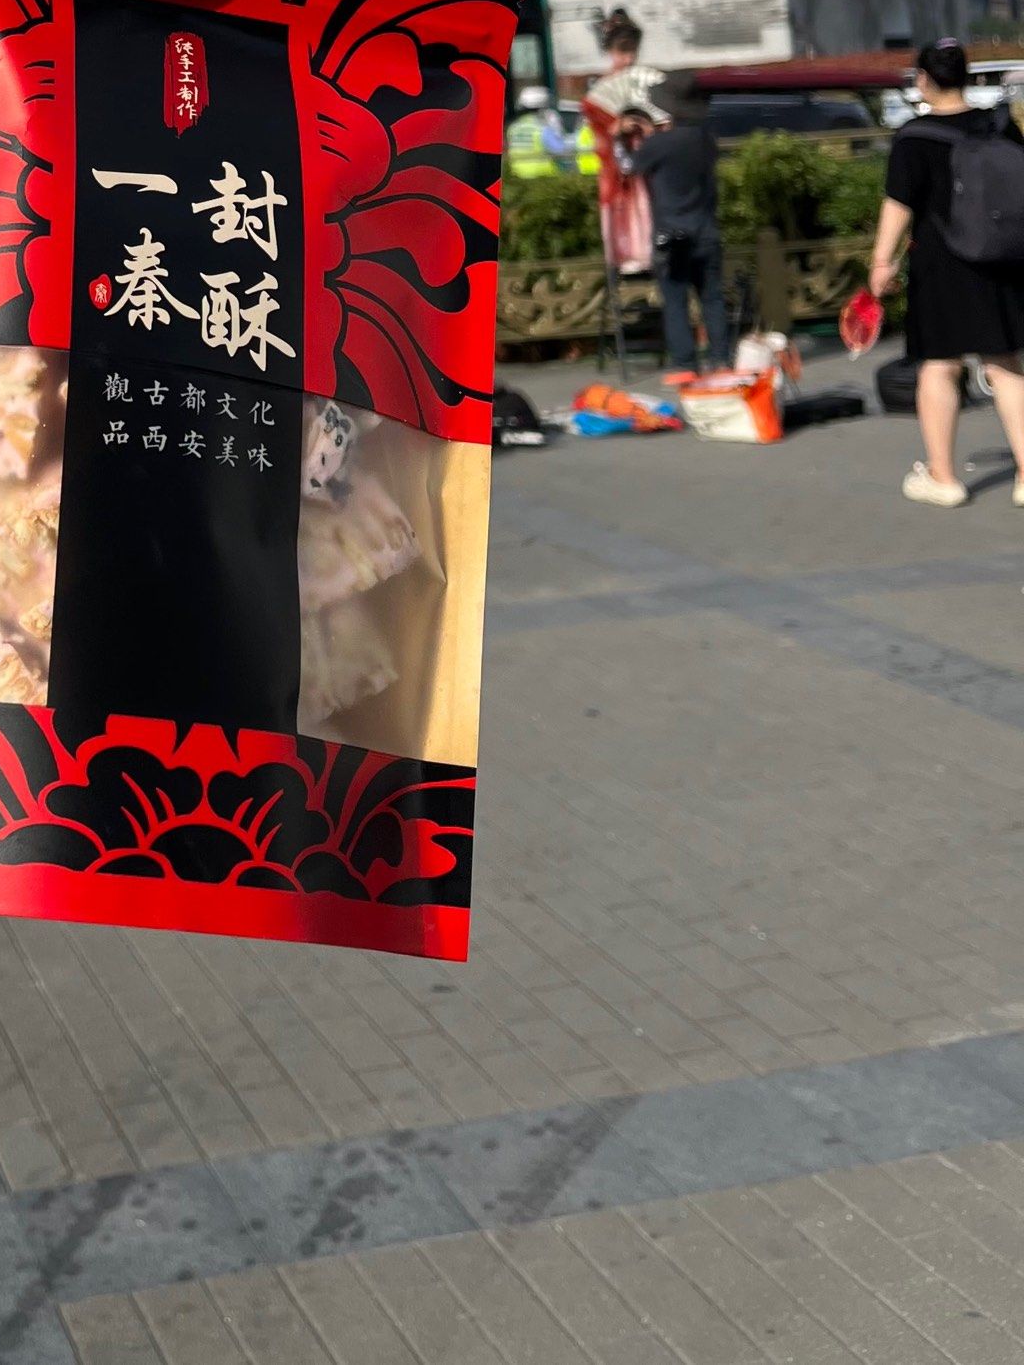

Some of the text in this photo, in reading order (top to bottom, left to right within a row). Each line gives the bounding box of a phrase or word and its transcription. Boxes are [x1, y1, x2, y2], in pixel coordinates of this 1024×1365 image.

[175, 37, 198, 120] 纯手工制作
[91, 161, 288, 262] 一封
[103, 227, 297, 372] 秦酥
[102, 373, 276, 426] 觀古都文化
[102, 420, 274, 473] 品西安美味
